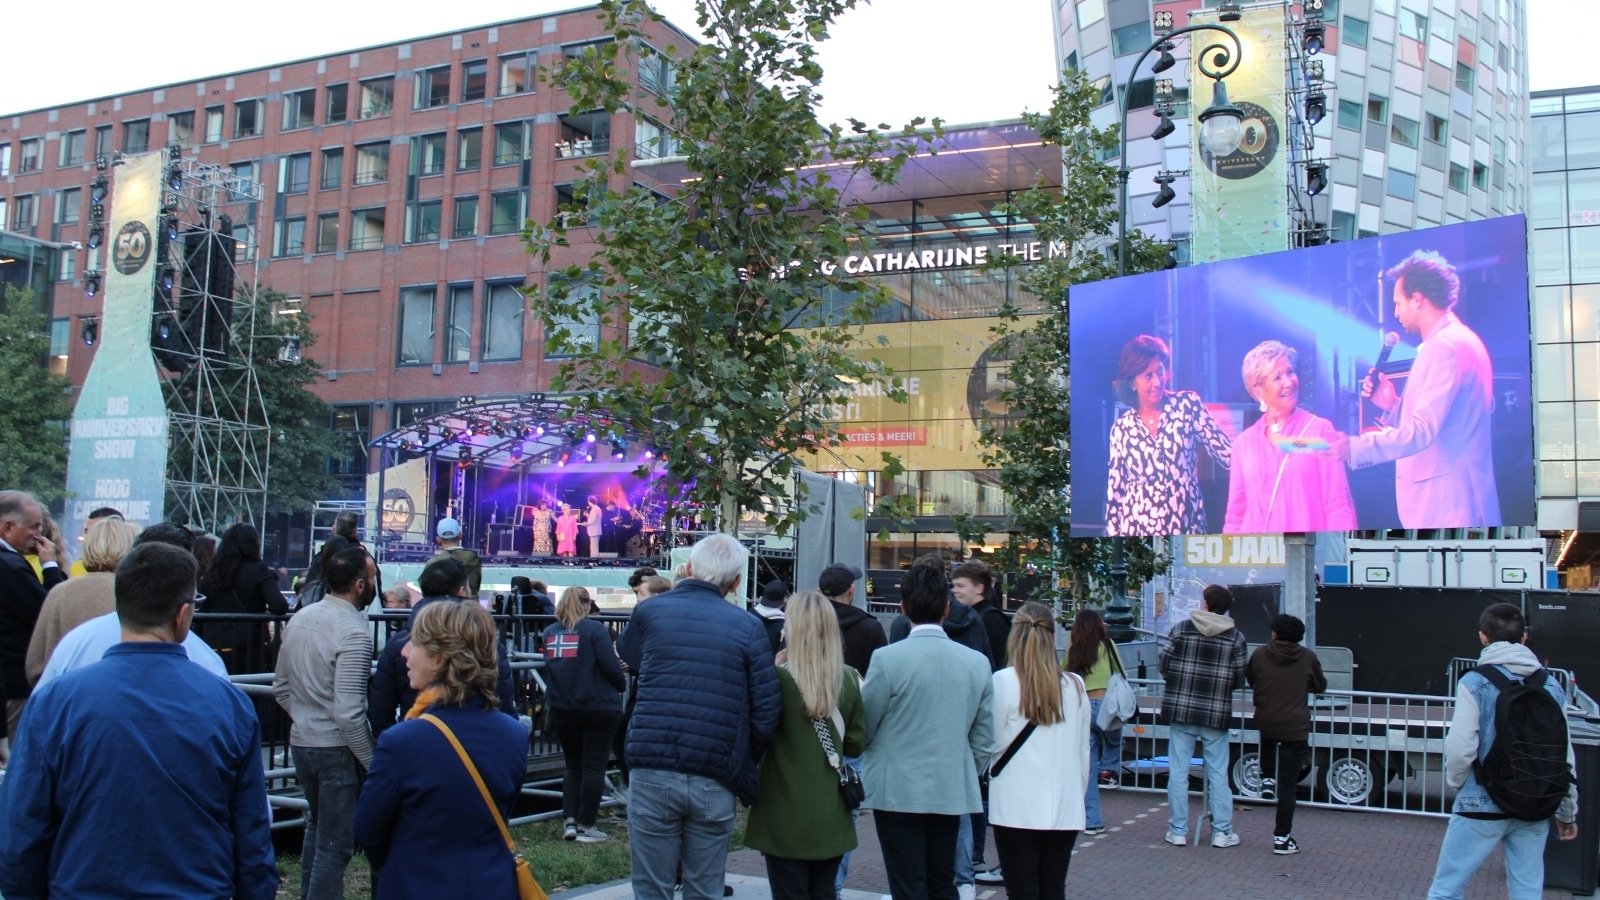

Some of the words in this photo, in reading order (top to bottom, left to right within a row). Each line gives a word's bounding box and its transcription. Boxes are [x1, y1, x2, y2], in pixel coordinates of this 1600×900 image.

[116, 231, 147, 259] 50
[844, 245, 988, 275] CATHARIJNE
[998, 241, 1041, 262] THE
[105, 396, 129, 416] BIG
[74, 416, 164, 438] ANNIVERSARY
[877, 432, 885, 442] &
[886, 430, 917, 442] MEER!
[94, 440, 137, 460] SHOW
[95, 479, 131, 499] HOOG
[382, 498, 409, 523] 50
[1187, 536, 1223, 565] 50
